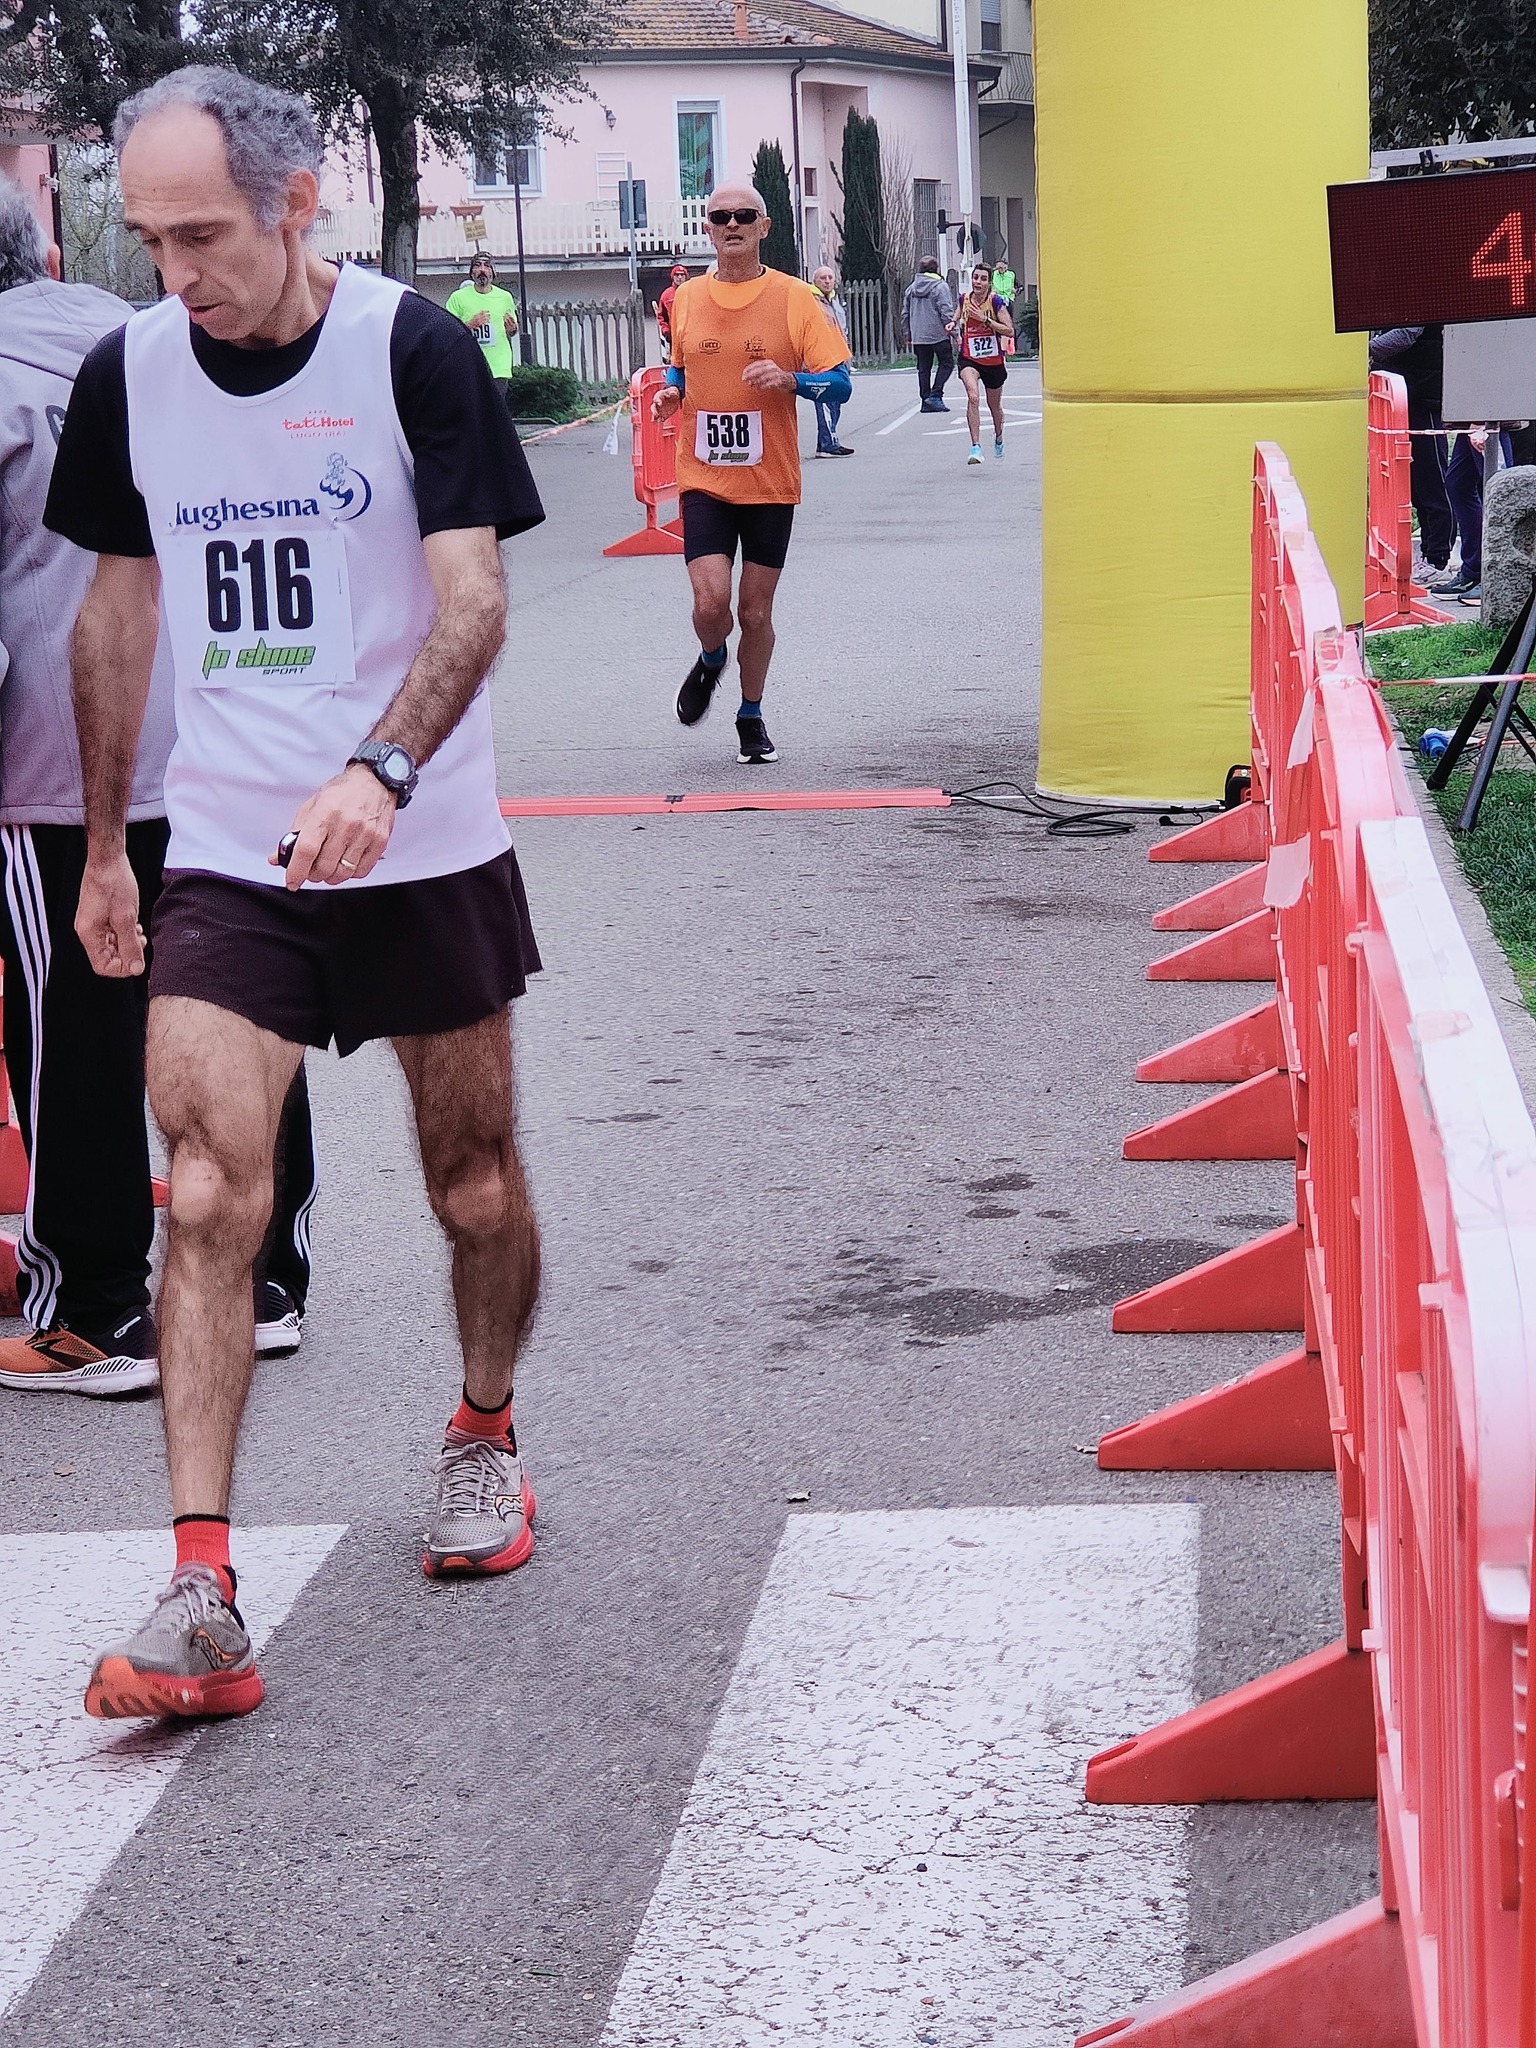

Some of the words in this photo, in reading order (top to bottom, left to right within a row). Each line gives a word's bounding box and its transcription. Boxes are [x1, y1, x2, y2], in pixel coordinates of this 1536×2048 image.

[1471, 211, 1536, 306] 4
[973, 337, 993, 351] 522
[706, 414, 750, 448] 538
[176, 497, 320, 531] lughesina
[205, 537, 314, 633] 616
[262, 666, 307, 676] SPORT
